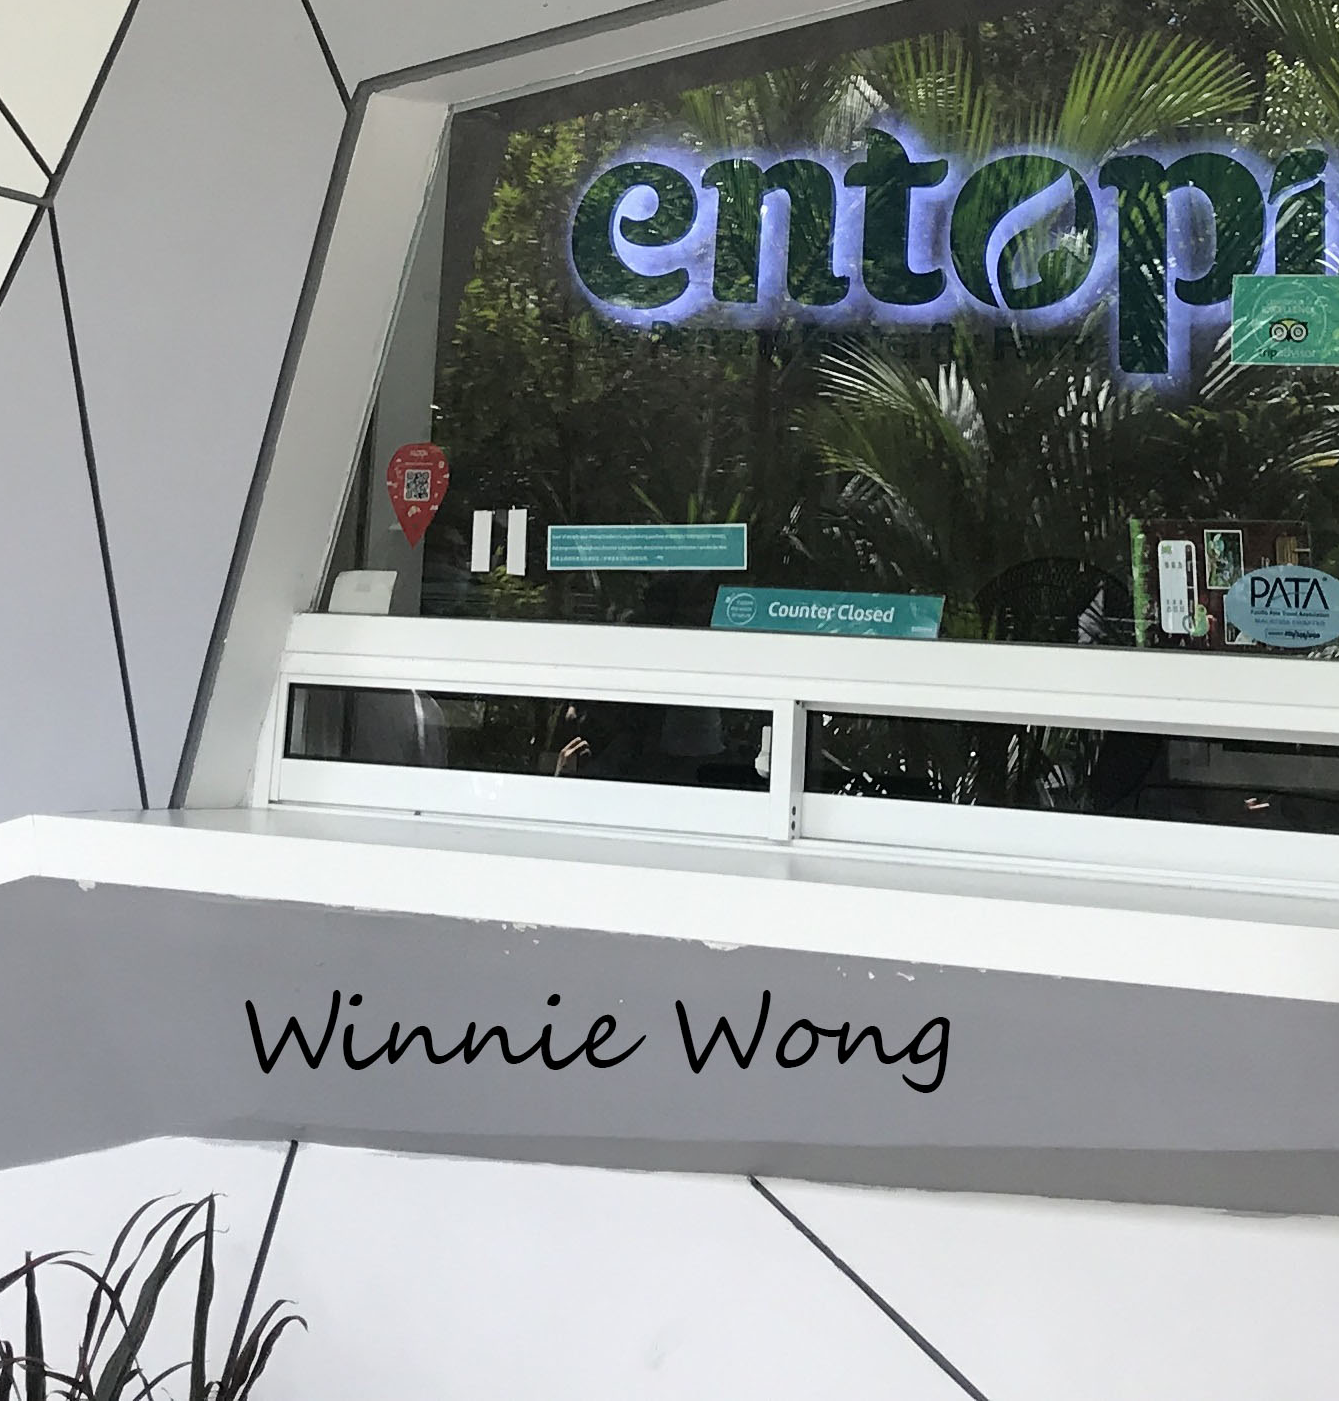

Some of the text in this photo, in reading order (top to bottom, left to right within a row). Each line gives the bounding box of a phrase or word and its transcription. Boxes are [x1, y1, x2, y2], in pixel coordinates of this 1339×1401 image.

[1250, 576, 1330, 610] PATA
[768, 601, 835, 621] Counter
[837, 605, 895, 623] Closed
